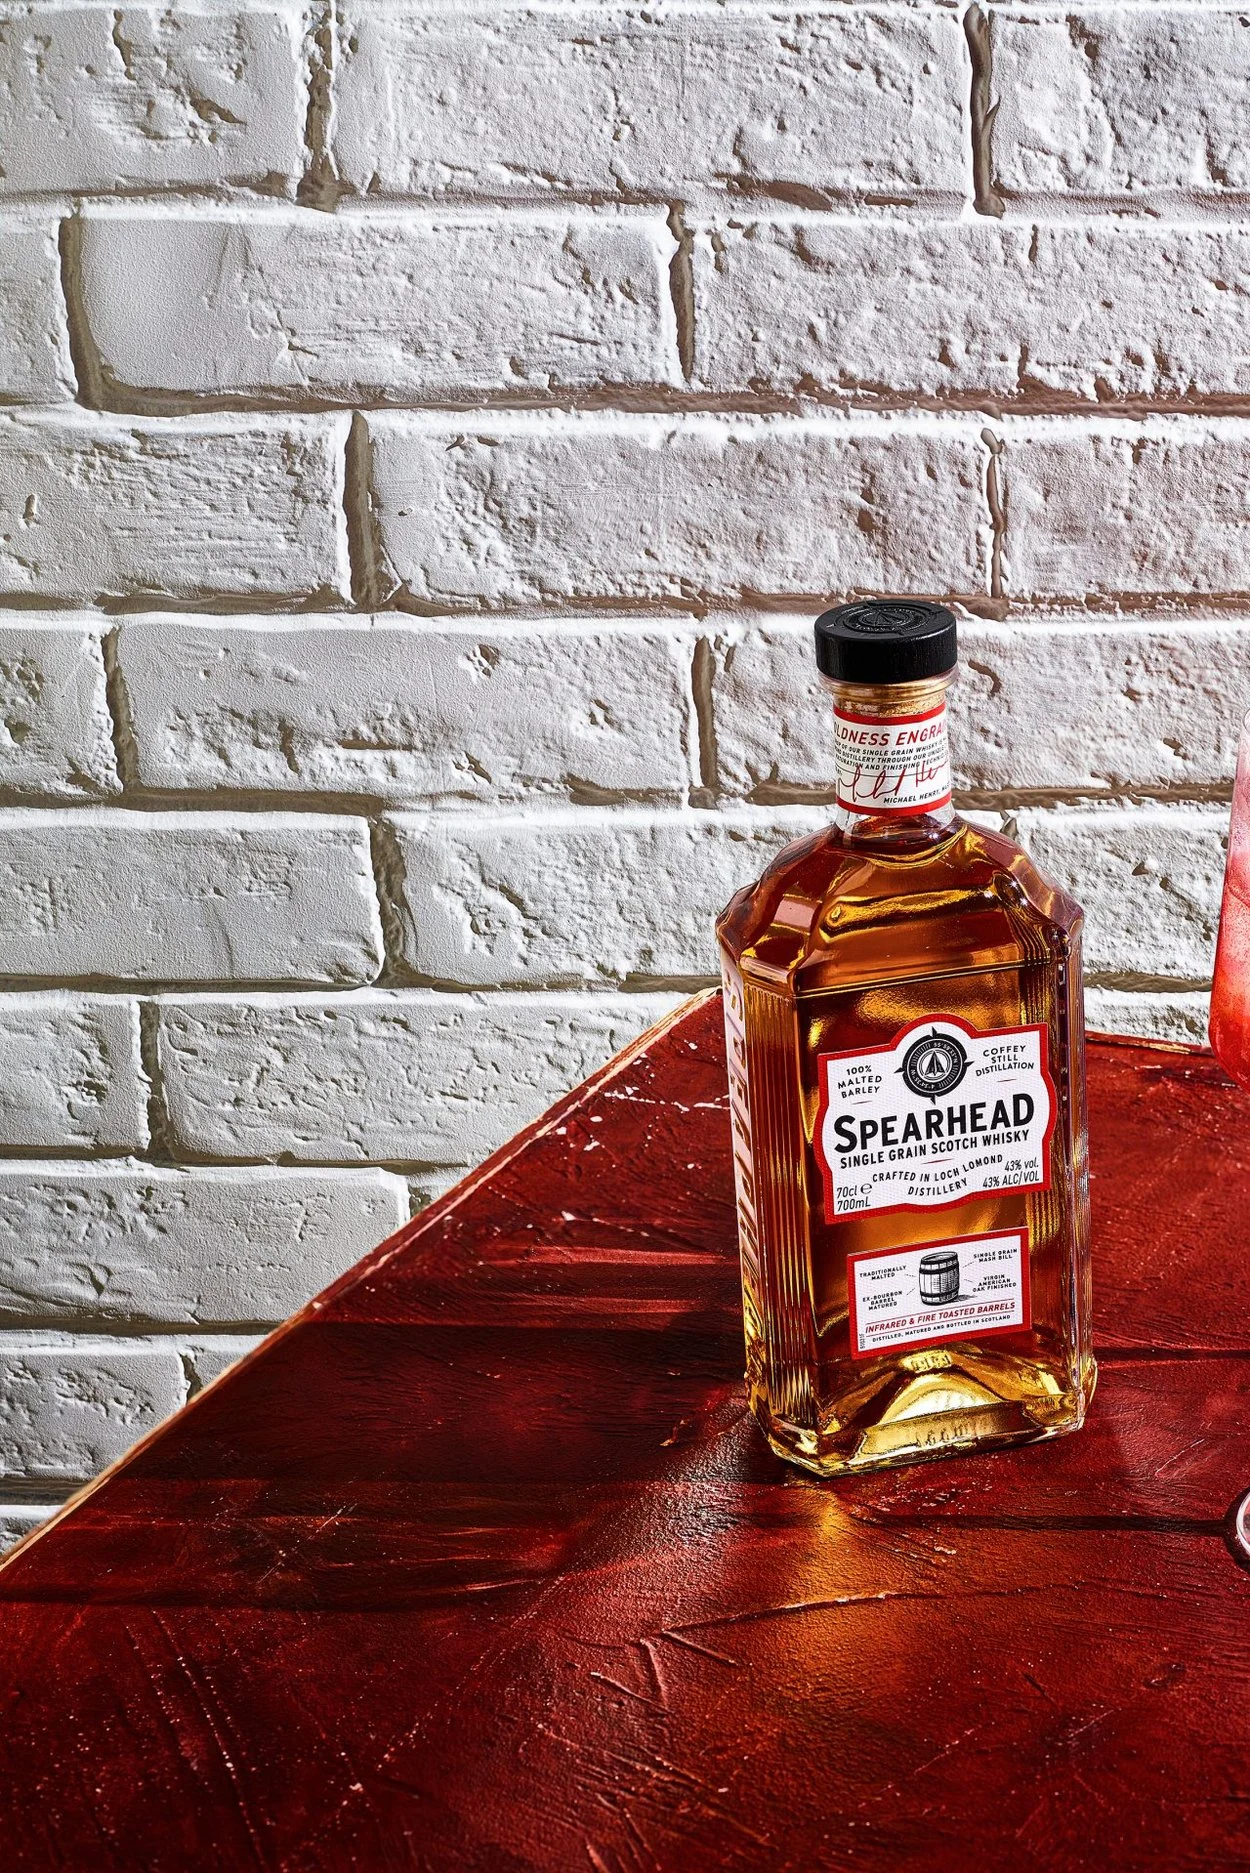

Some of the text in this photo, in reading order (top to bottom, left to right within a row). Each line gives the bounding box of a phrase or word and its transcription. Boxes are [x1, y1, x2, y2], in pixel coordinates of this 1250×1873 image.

[862, 747, 889, 756] SINGLE
[891, 748, 913, 756] GRAIN
[916, 741, 938, 752] WHISKY
[842, 751, 875, 763] DISTILLERY
[882, 762, 920, 771] FINISHING
[884, 796, 916, 804] MICHAEL
[983, 1045, 1027, 1057] COFFEY
[991, 1054, 1019, 1064] STILL
[846, 1065, 872, 1075] 100%
[975, 1061, 1034, 1077] DISTILLATION
[837, 1075, 882, 1090] MALTED
[841, 1086, 880, 1098] BARLEY
[833, 1093, 1034, 1153] SPEARHEAD
[840, 1129, 1030, 1169] SINGLE GRAIN SCOTCH WHISKY
[724, 968, 768, 1372] SPEARHEA
[872, 1154, 1003, 1182] CRAFTED IN LOCH LOMOND
[1005, 1157, 1039, 1172] 43% vol.
[982, 1170, 1039, 1189] 43% ALC/VOL
[837, 1186, 857, 1199] 70cl
[908, 1178, 968, 1196] DISTILLERY
[837, 1196, 871, 1212] 700mL
[973, 1251, 996, 1259] SINGLE
[859, 1265, 906, 1278] TRADITIONALLY
[871, 1272, 895, 1280] MALTED
[978, 1278, 1011, 1287] AMERICAN
[987, 1282, 1017, 1290] FINISHED
[862, 1290, 903, 1302] EX-BOURBON
[871, 1297, 895, 1305] BARREL
[868, 1301, 897, 1311] MATURED
[865, 1319, 907, 1334] INFRARED
[917, 1313, 936, 1323] FIRE
[939, 1307, 975, 1319] TOASTED
[977, 1302, 1015, 1313] BARRELS
[872, 1333, 904, 1342] DISTILLED,
[905, 1327, 931, 1335] MATURED
[946, 1320, 972, 1328] BOTTLED
[981, 1314, 1011, 1323] SCOTLAND
